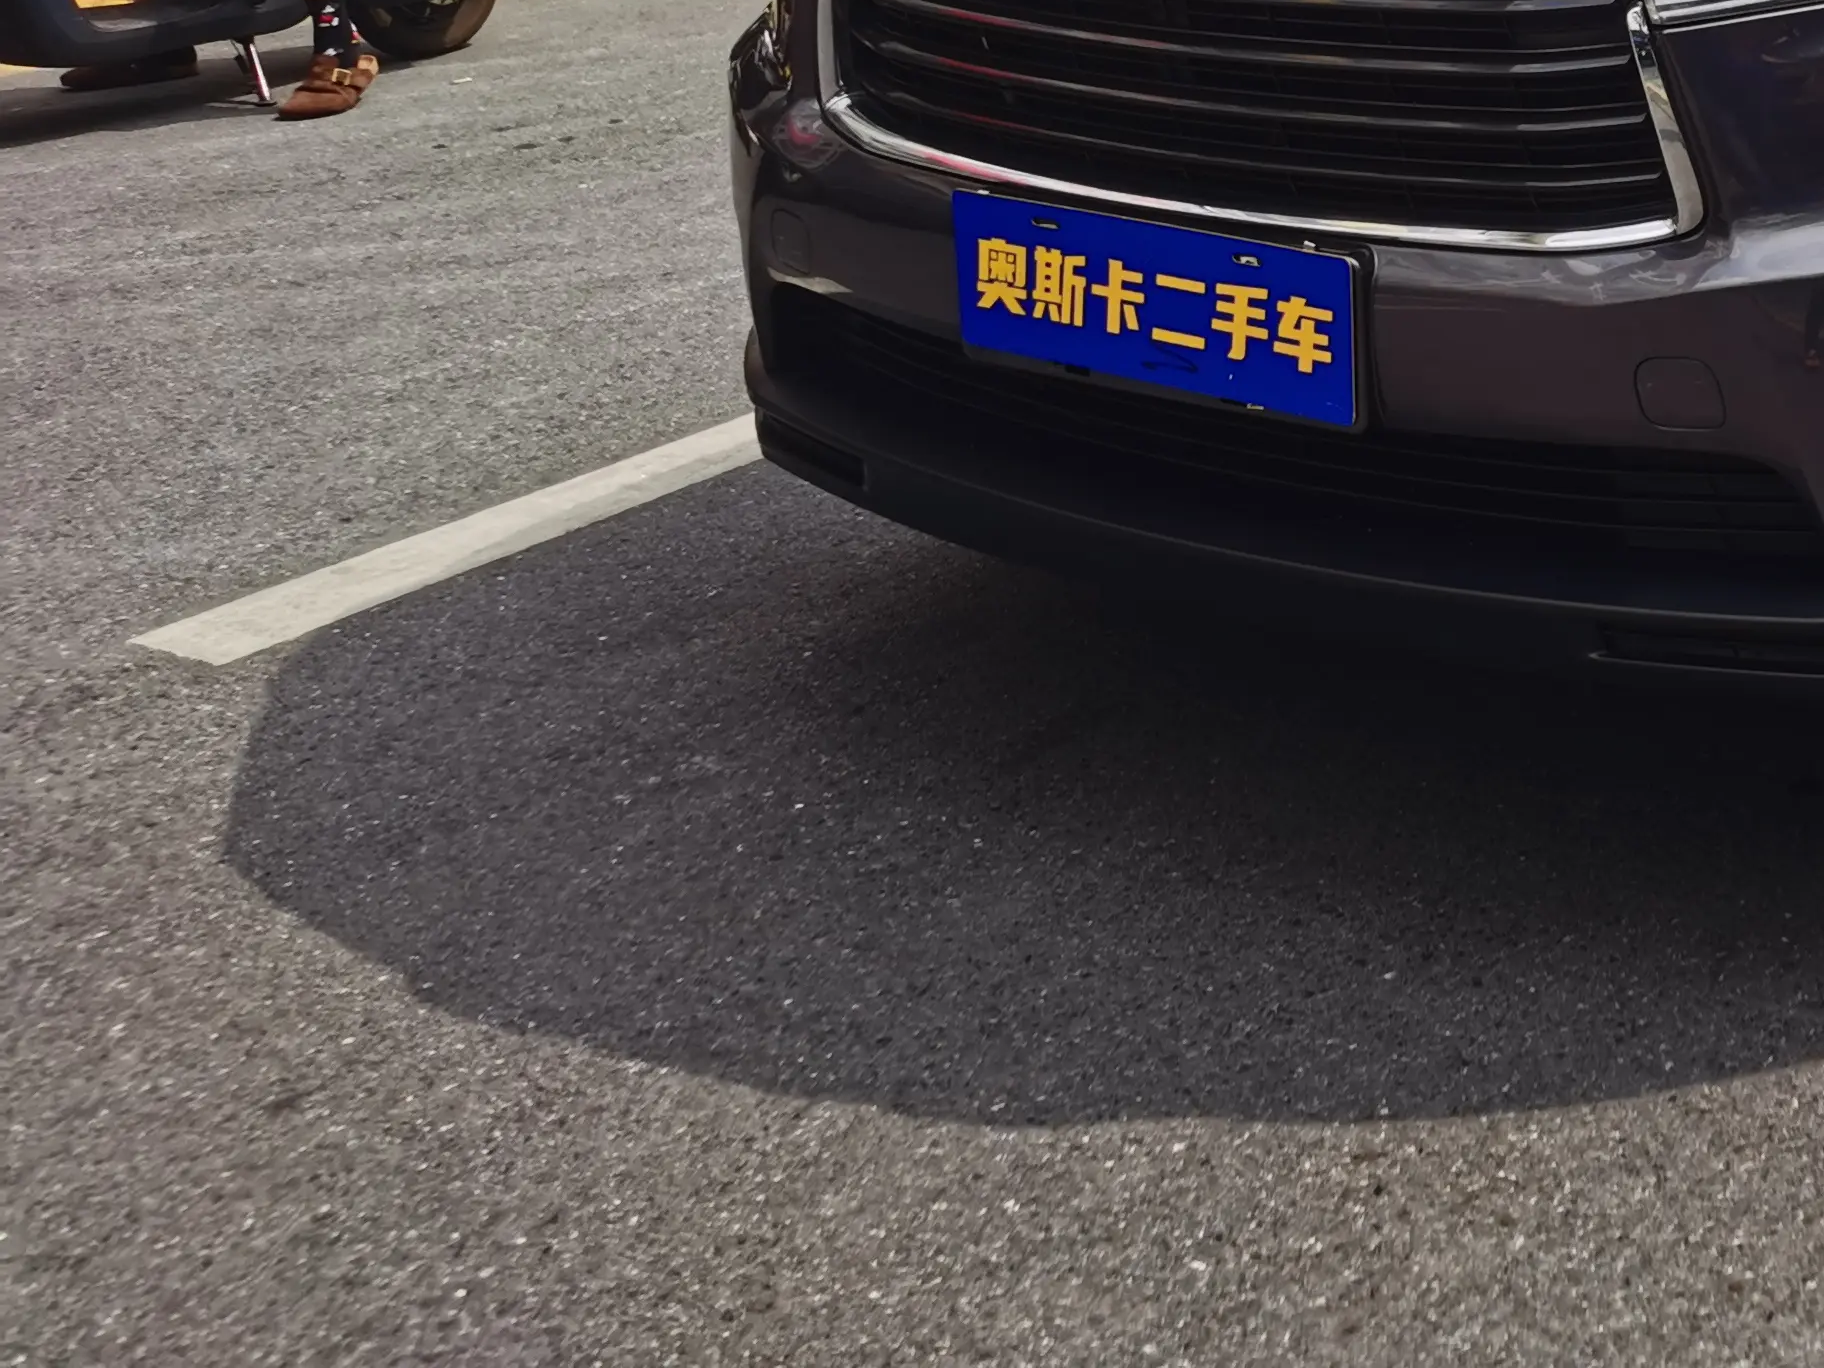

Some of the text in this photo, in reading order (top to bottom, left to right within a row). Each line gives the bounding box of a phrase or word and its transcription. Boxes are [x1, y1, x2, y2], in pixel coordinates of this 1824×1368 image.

[976, 237, 1333, 374] 奥斯卡二手车
